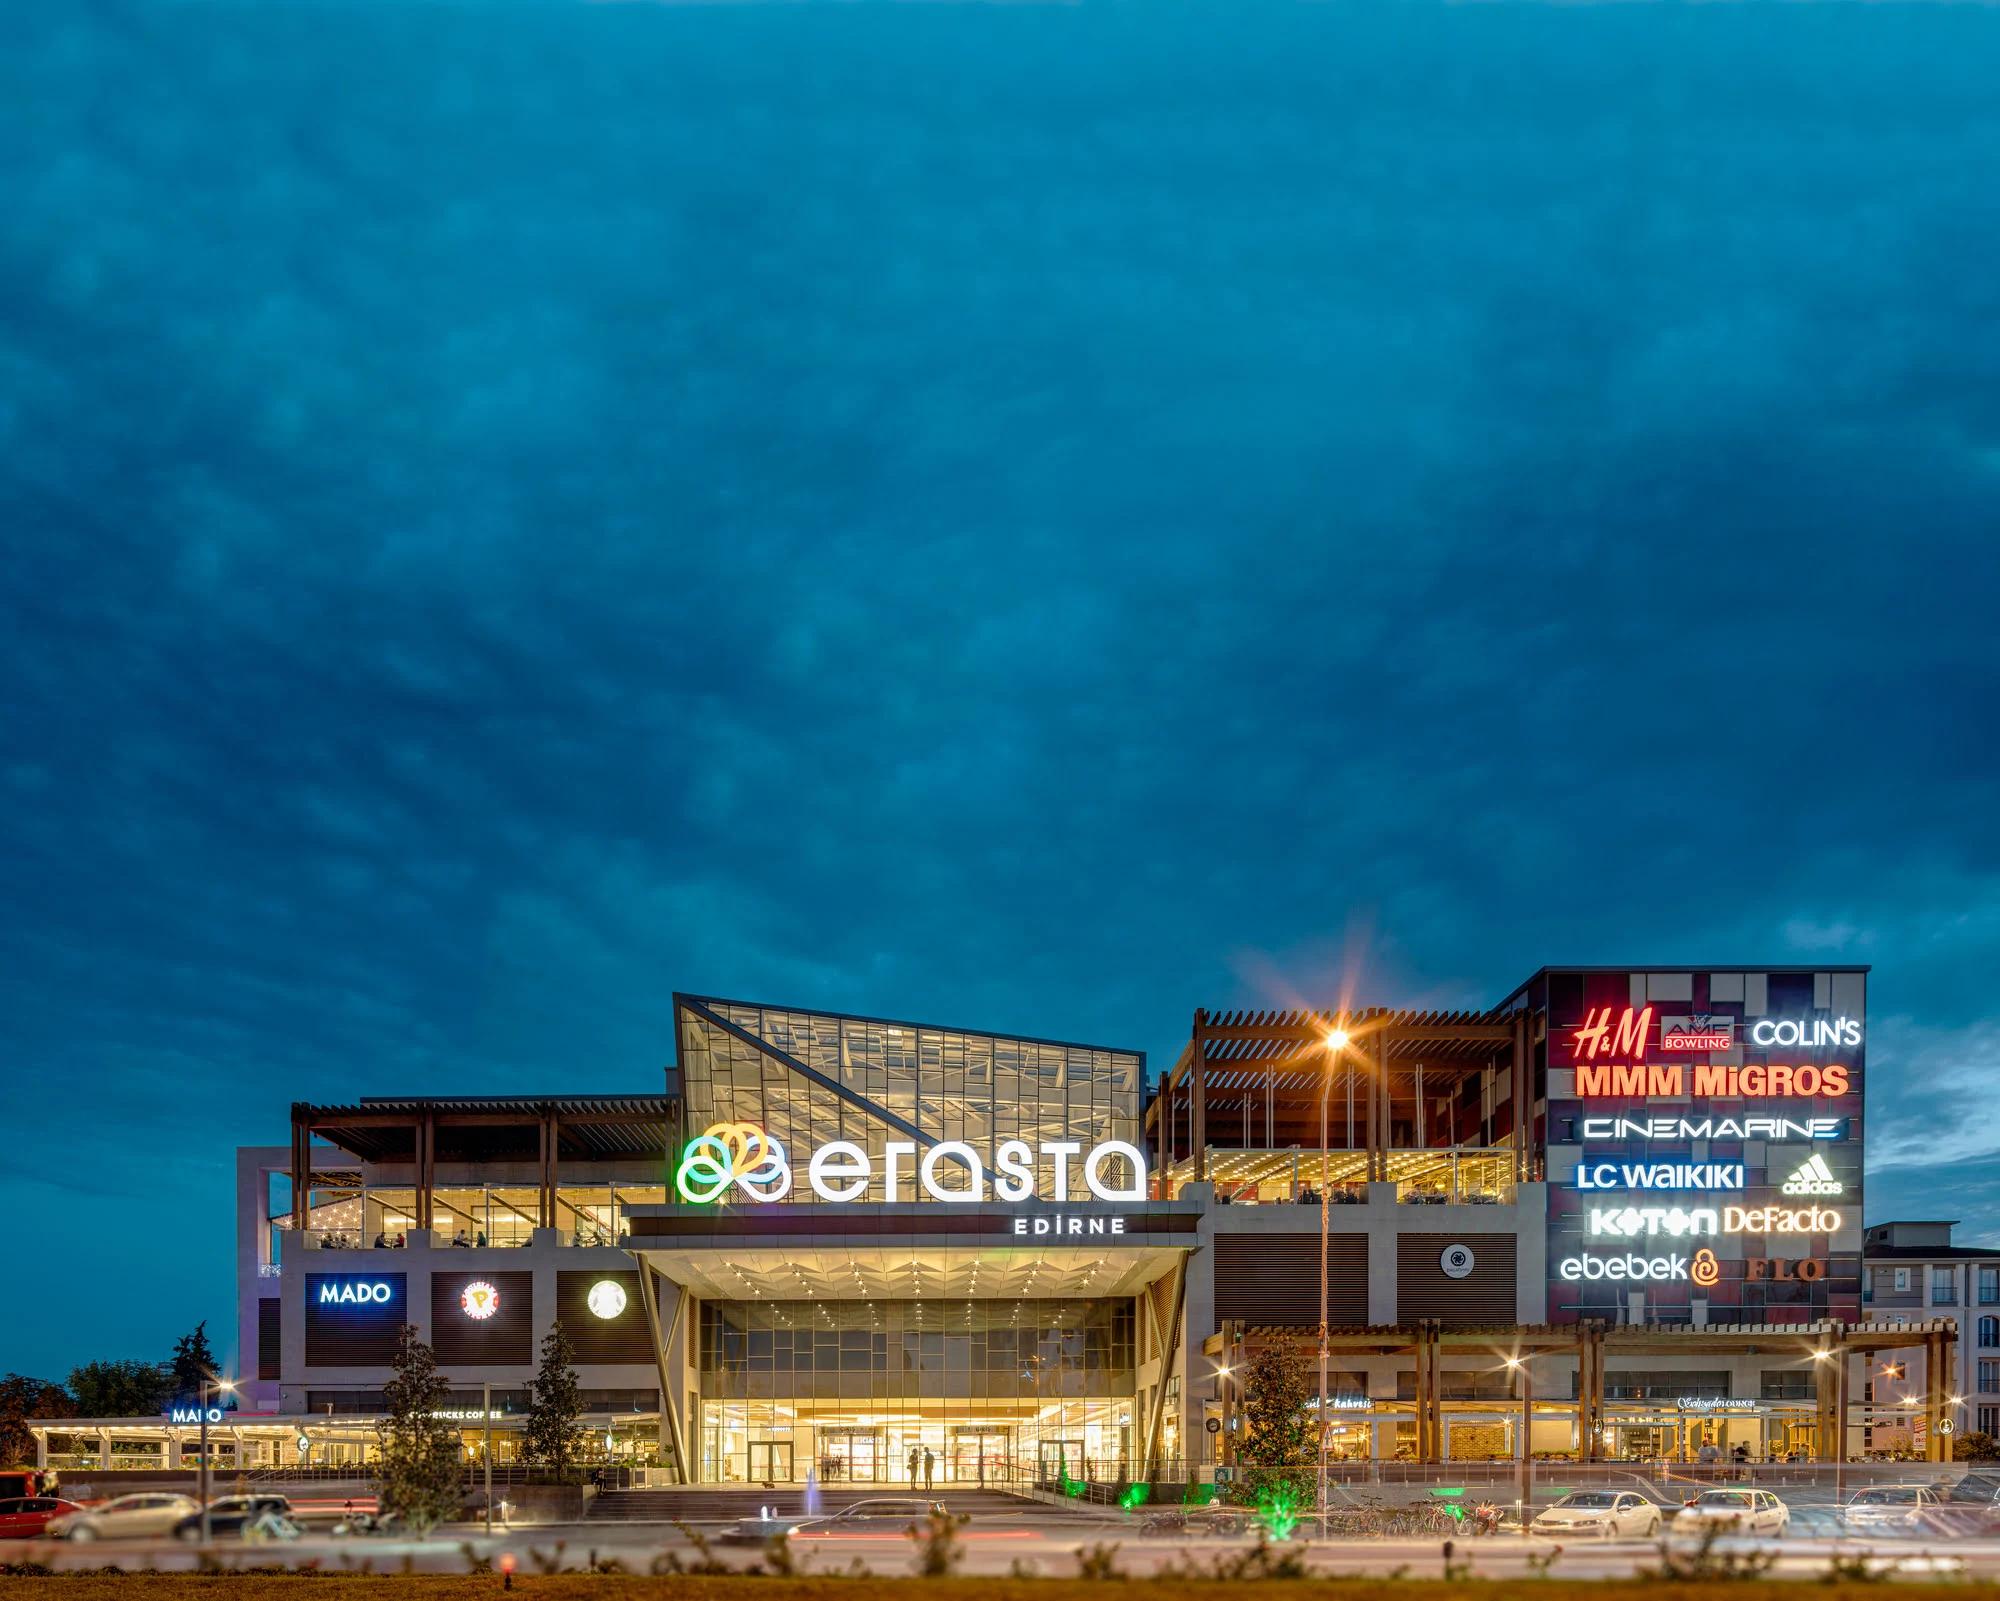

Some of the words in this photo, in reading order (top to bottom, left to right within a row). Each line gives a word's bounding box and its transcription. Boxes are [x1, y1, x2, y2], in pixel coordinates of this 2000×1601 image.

[1572, 1008, 1653, 1059] H&M
[1664, 1037, 1730, 1049] BOWLING
[1752, 1017, 1861, 1046] COLIN'S
[1575, 1066, 1683, 1097] MMM
[1583, 1119, 1839, 1138] CINEMARINE
[1578, 1164, 1618, 1188] LC
[1782, 1179, 1843, 1195] adidas
[1724, 1206, 1841, 1232] DeFacto
[1561, 1253, 1687, 1280] ebebek
[1747, 1258, 1825, 1282] FLO
[320, 1283, 391, 1303] MADO
[466, 1411, 502, 1419] COFEE
